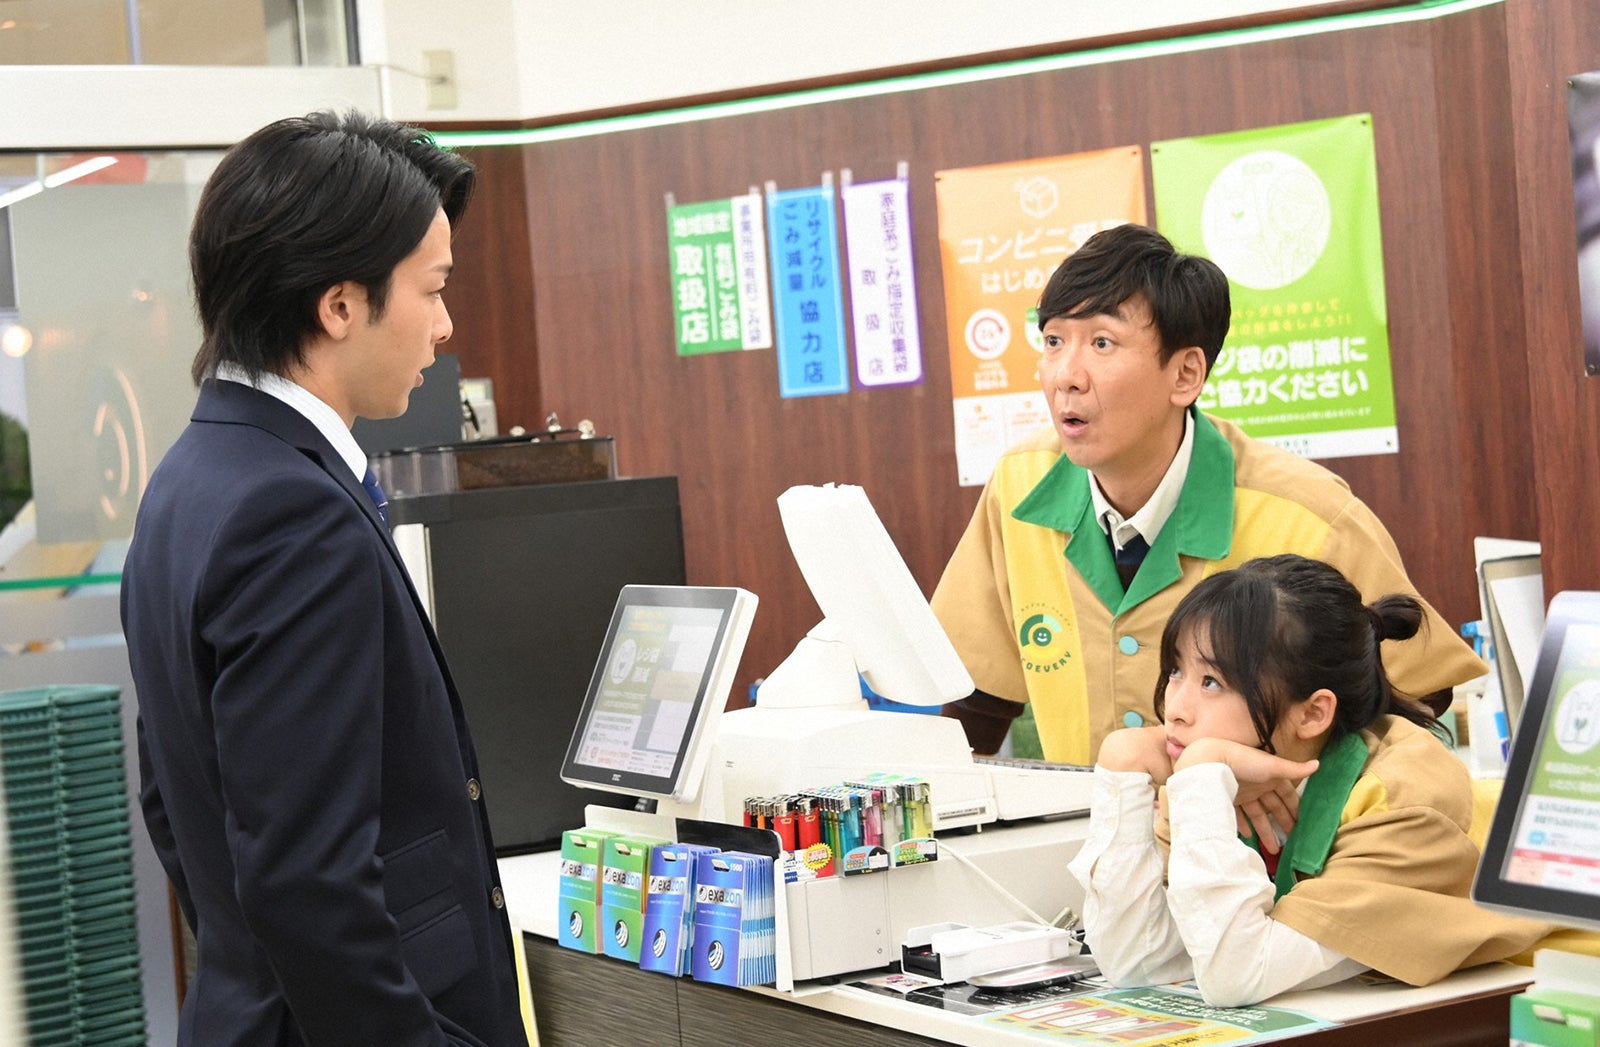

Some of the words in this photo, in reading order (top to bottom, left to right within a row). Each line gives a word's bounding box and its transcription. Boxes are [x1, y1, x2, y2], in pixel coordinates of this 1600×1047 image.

[784, 202, 804, 291] ごみ減量
[805, 202, 827, 289] リサイクル
[675, 244, 709, 344] 取扱店
[800, 301, 824, 384] 協力店
[1197, 369, 1369, 408] ご協力ください
[569, 863, 595, 879] exazon
[612, 871, 641, 887] exazon
[657, 878, 685, 892] exazon
[707, 888, 741, 904] exazon
